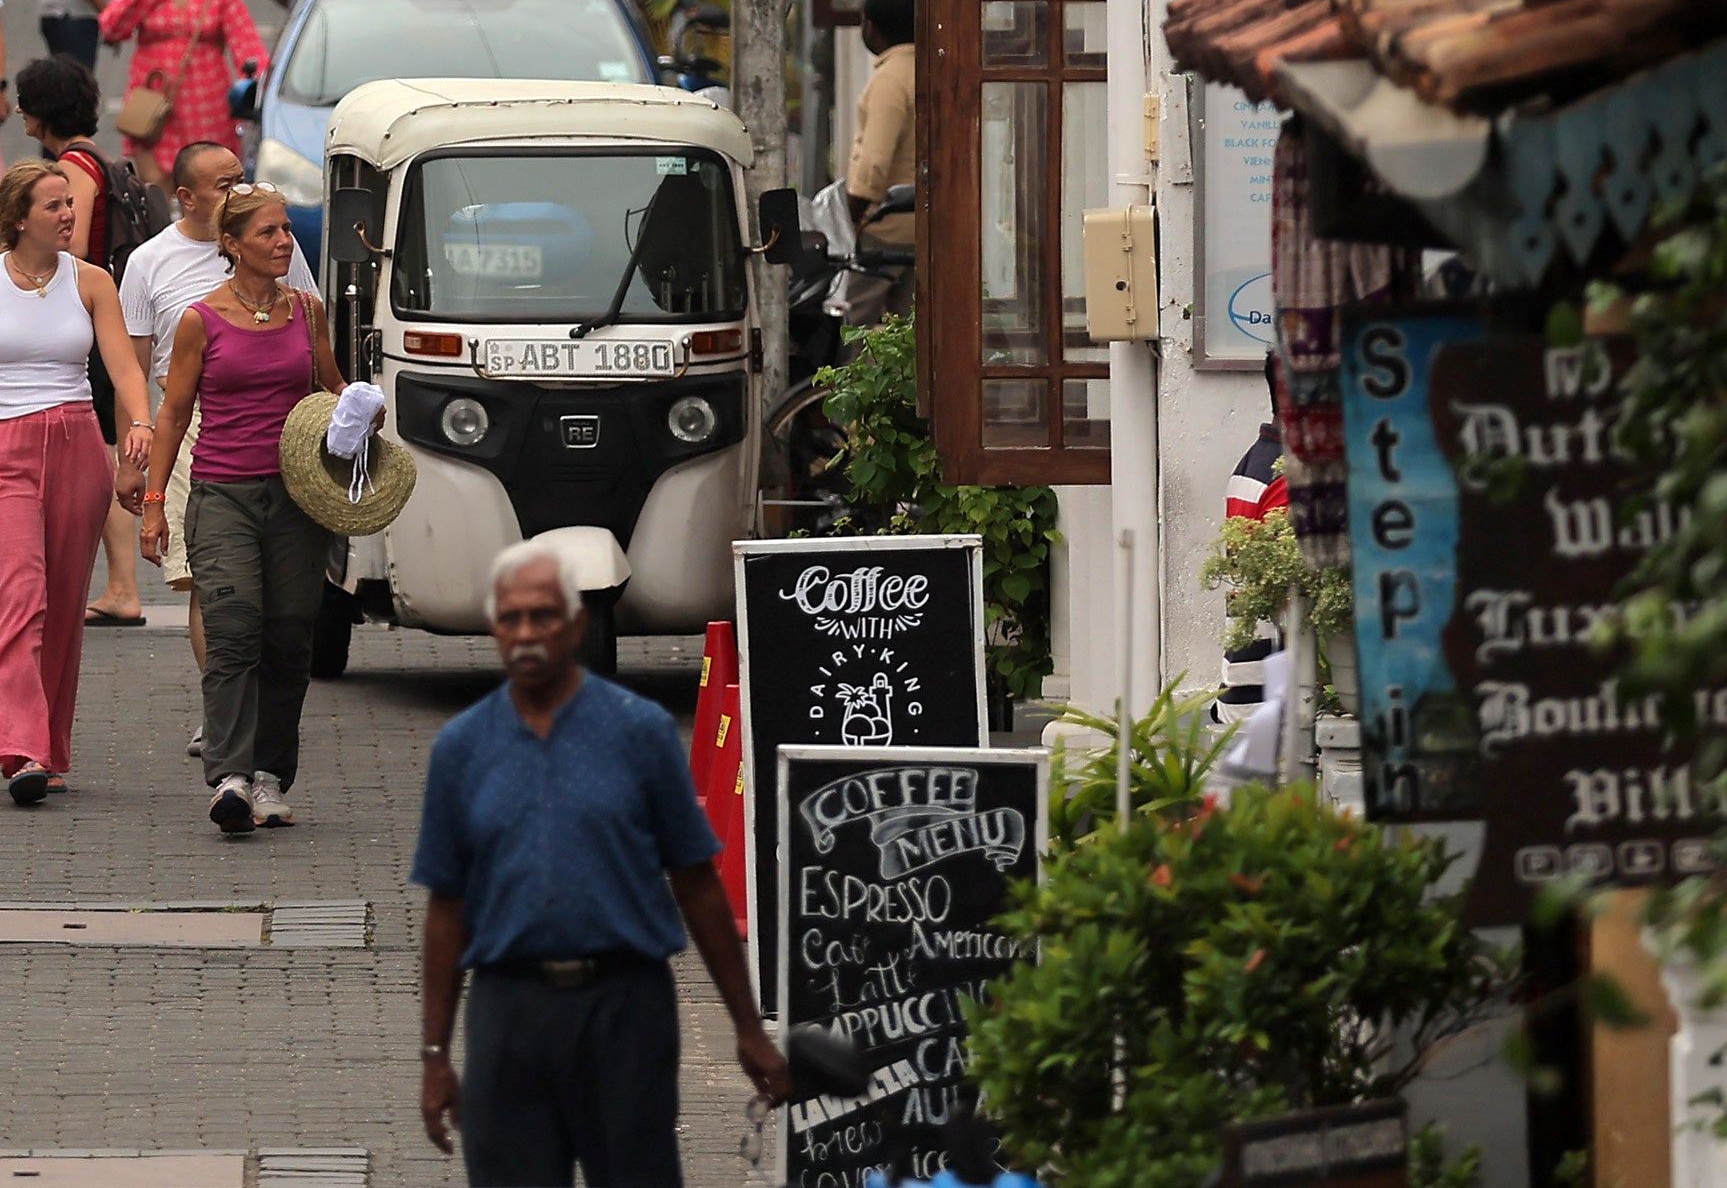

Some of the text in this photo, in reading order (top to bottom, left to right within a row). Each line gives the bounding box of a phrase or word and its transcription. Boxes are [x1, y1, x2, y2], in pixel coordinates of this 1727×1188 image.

[1225, 139, 1258, 147] BLACK
[491, 344, 670, 372] SP ABT 1880
[568, 427, 594, 441] RE
[779, 565, 929, 613] Coffee
[840, 617, 893, 640] WITH
[810, 644, 923, 718] DAIRY KING
[815, 769, 973, 826] COFFEE
[898, 812, 1006, 869] MENU
[801, 865, 951, 923] ESPRESSO
